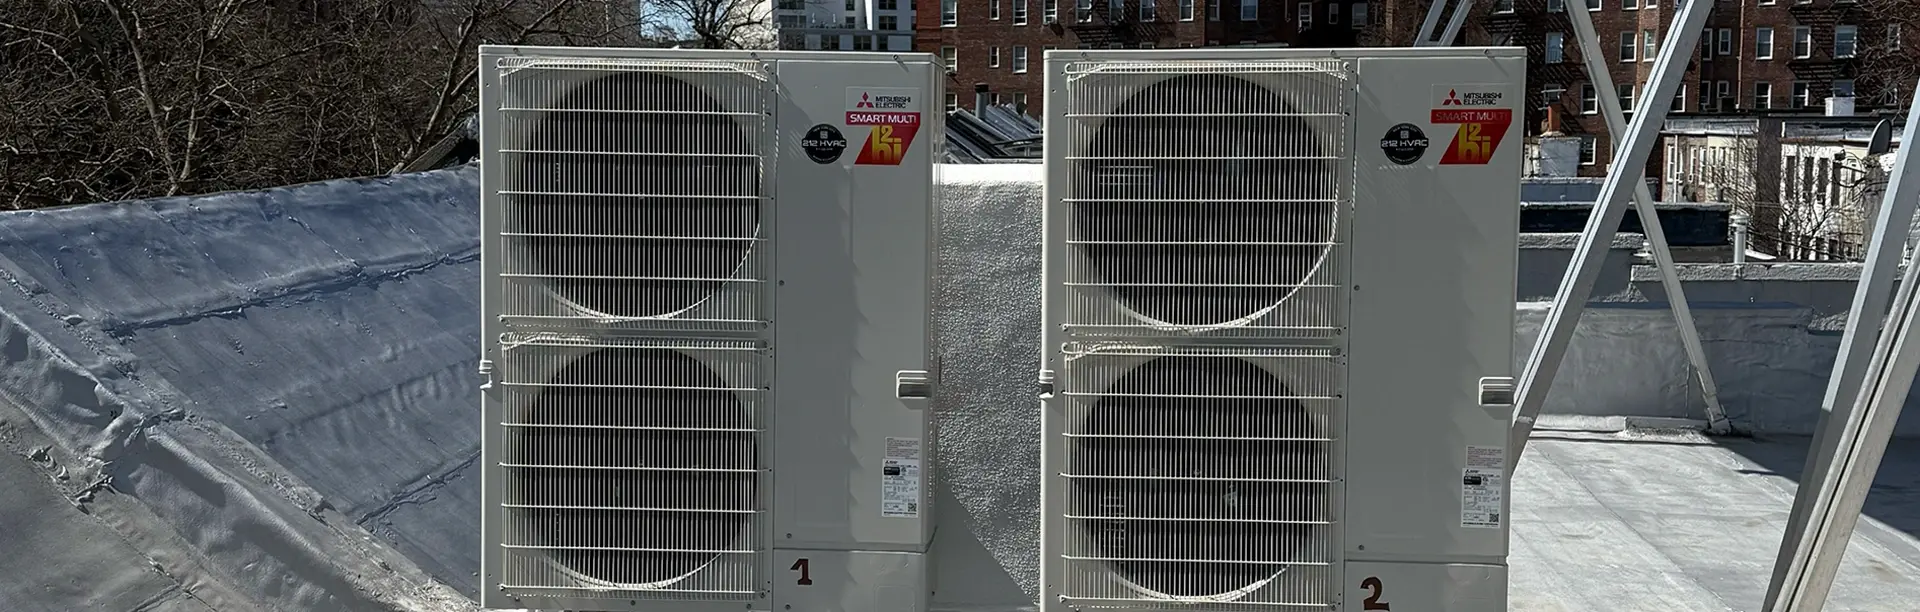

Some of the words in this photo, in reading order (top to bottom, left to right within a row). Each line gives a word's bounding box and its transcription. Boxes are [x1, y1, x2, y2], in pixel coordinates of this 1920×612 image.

[850, 113, 886, 124] SMART
[887, 114, 917, 124] MULTI
[1435, 111, 1475, 121] SMART
[1476, 111, 1507, 121] MULTI
[802, 139, 818, 147] 212
[819, 139, 846, 147] HVAC
[1381, 139, 1398, 148] 212
[1399, 139, 1428, 147] HVAC
[790, 558, 813, 586] 1
[1360, 576, 1391, 612] 2
